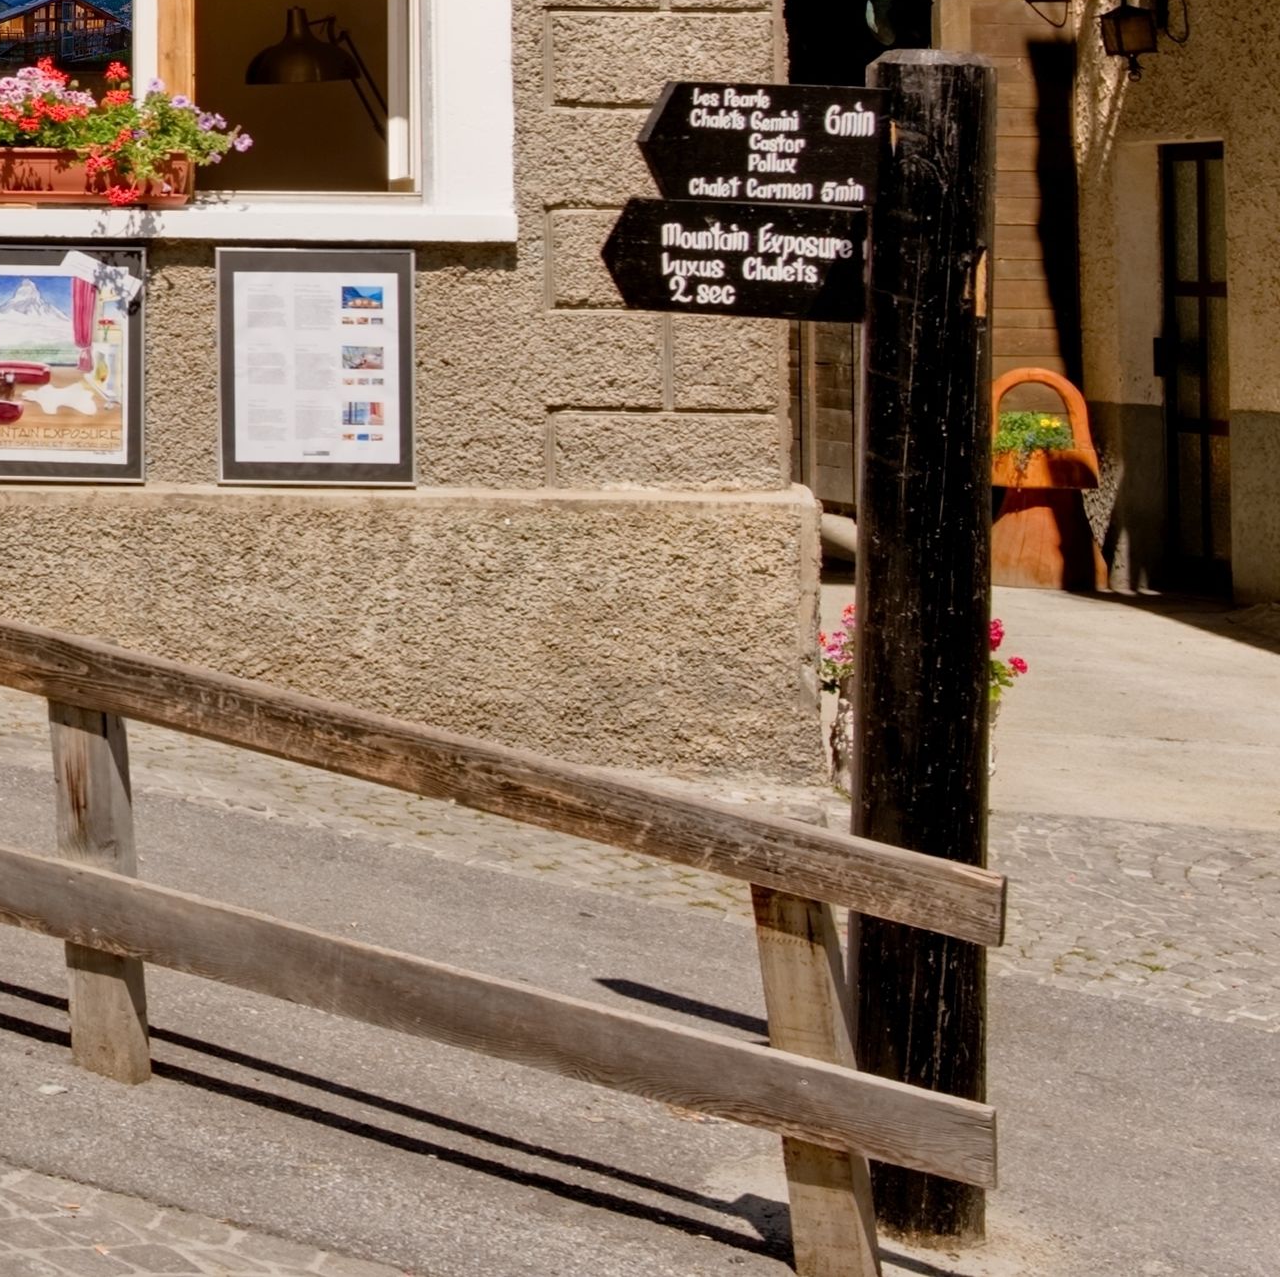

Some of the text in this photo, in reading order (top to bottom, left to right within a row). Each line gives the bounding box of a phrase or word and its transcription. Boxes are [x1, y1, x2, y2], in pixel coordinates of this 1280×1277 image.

[693, 87, 720, 108] Les
[690, 108, 800, 132] Chalets Gemini
[824, 101, 876, 138] 6min
[749, 133, 806, 154] Castor
[748, 153, 798, 174] Pollux
[689, 176, 865, 204] Chalet Carmen 5min
[661, 222, 854, 260] Mountain Exposure
[661, 252, 819, 284] Luxus Chalets
[669, 275, 737, 305] 2 sec
[43, 428, 120, 440] EXPOSURE
